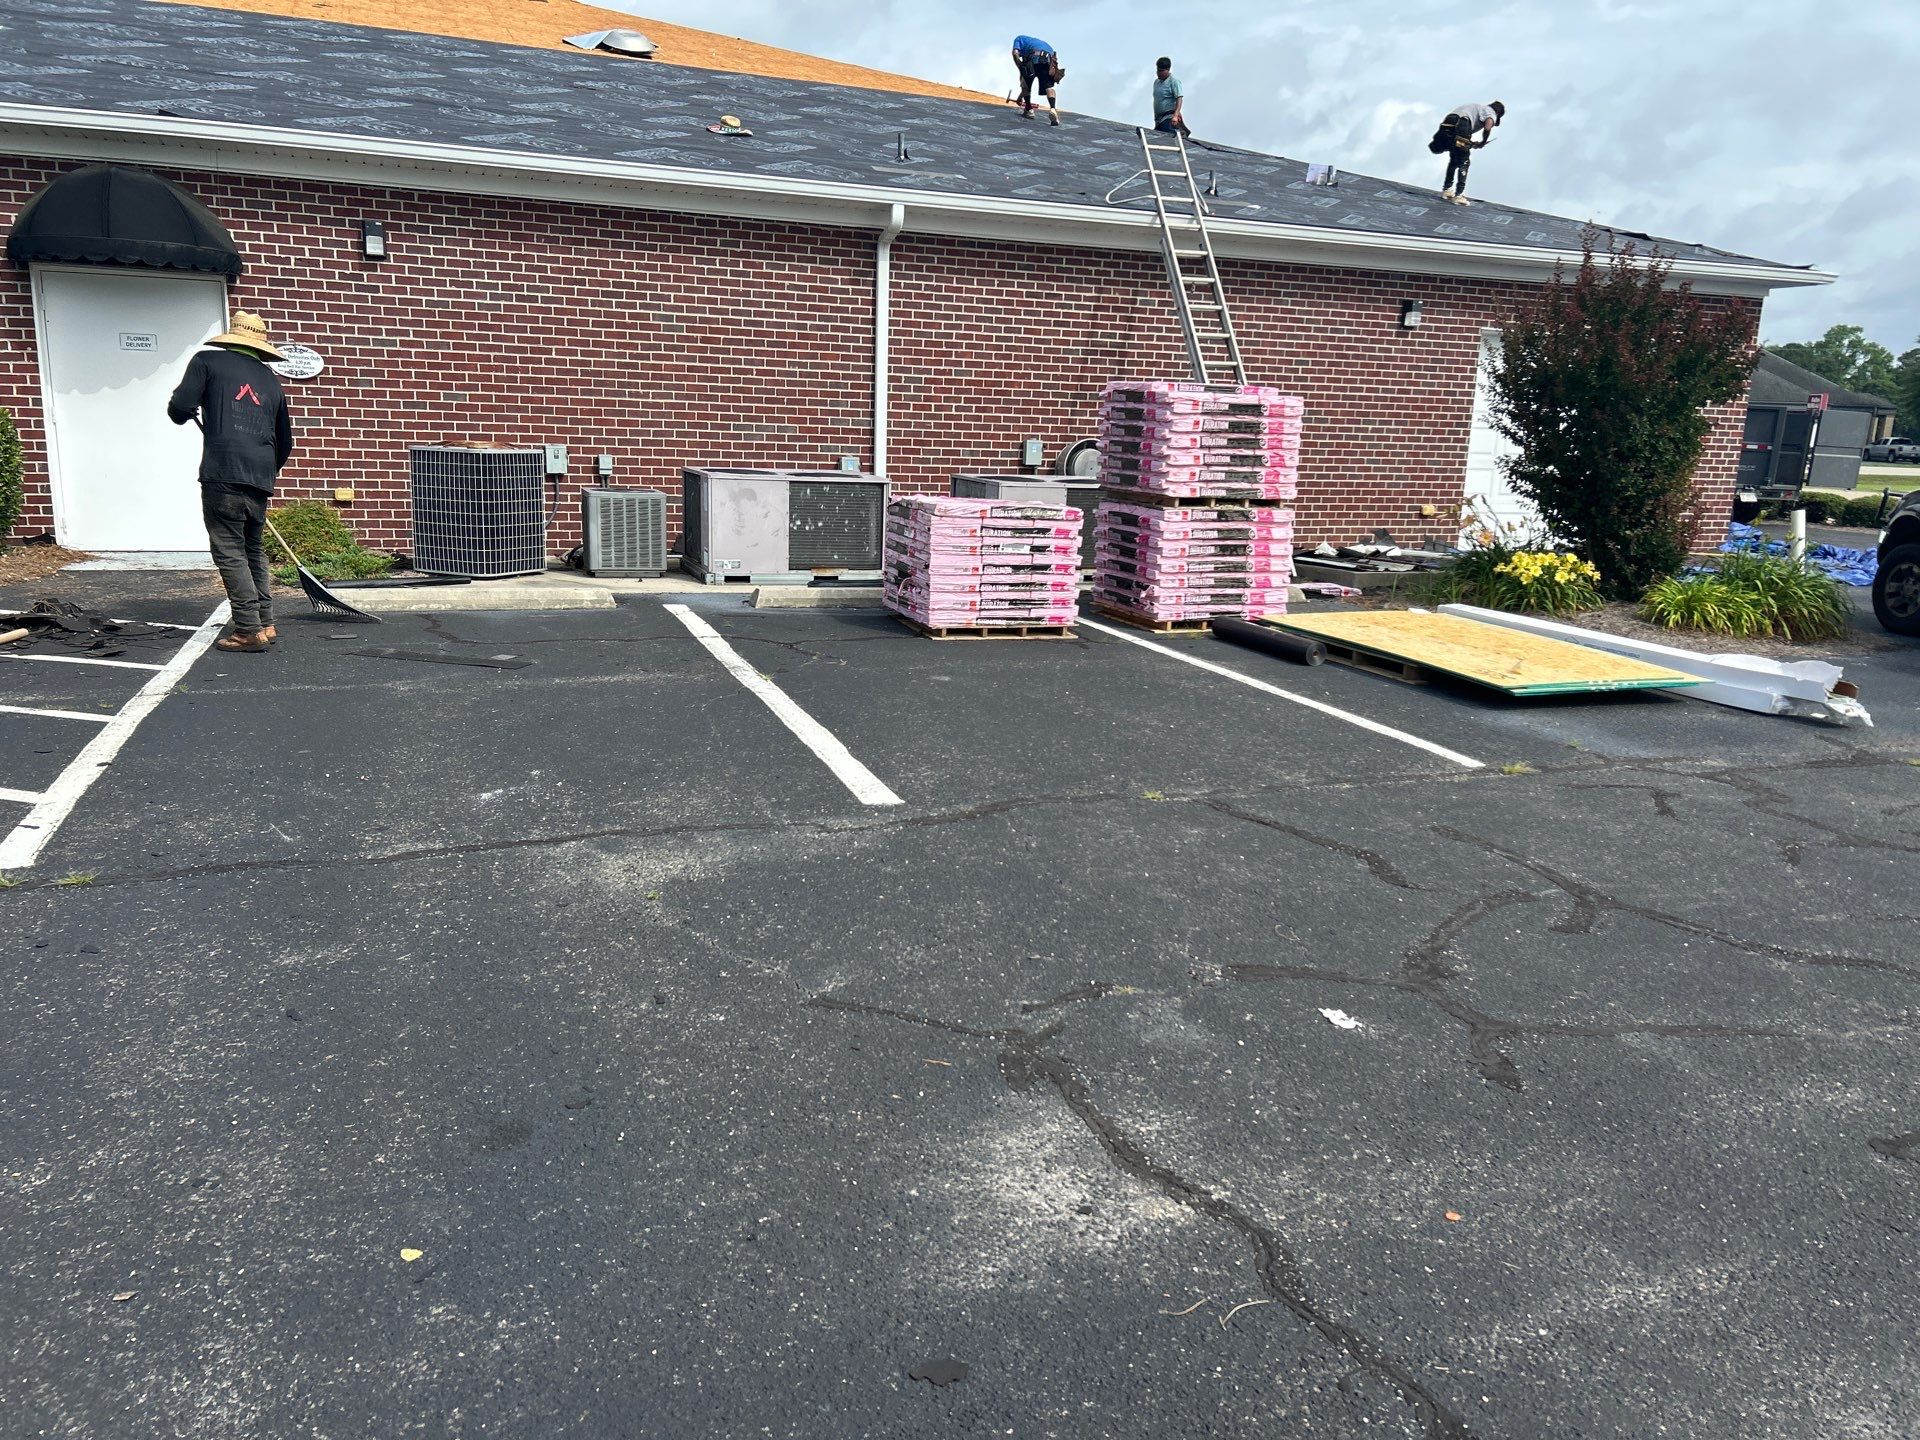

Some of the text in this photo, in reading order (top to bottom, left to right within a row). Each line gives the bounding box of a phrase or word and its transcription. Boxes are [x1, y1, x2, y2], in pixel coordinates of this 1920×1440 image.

[1202, 438, 1227, 446] DURATION
[1200, 472, 1226, 480] DURATION
[1201, 488, 1226, 496] DURATION
